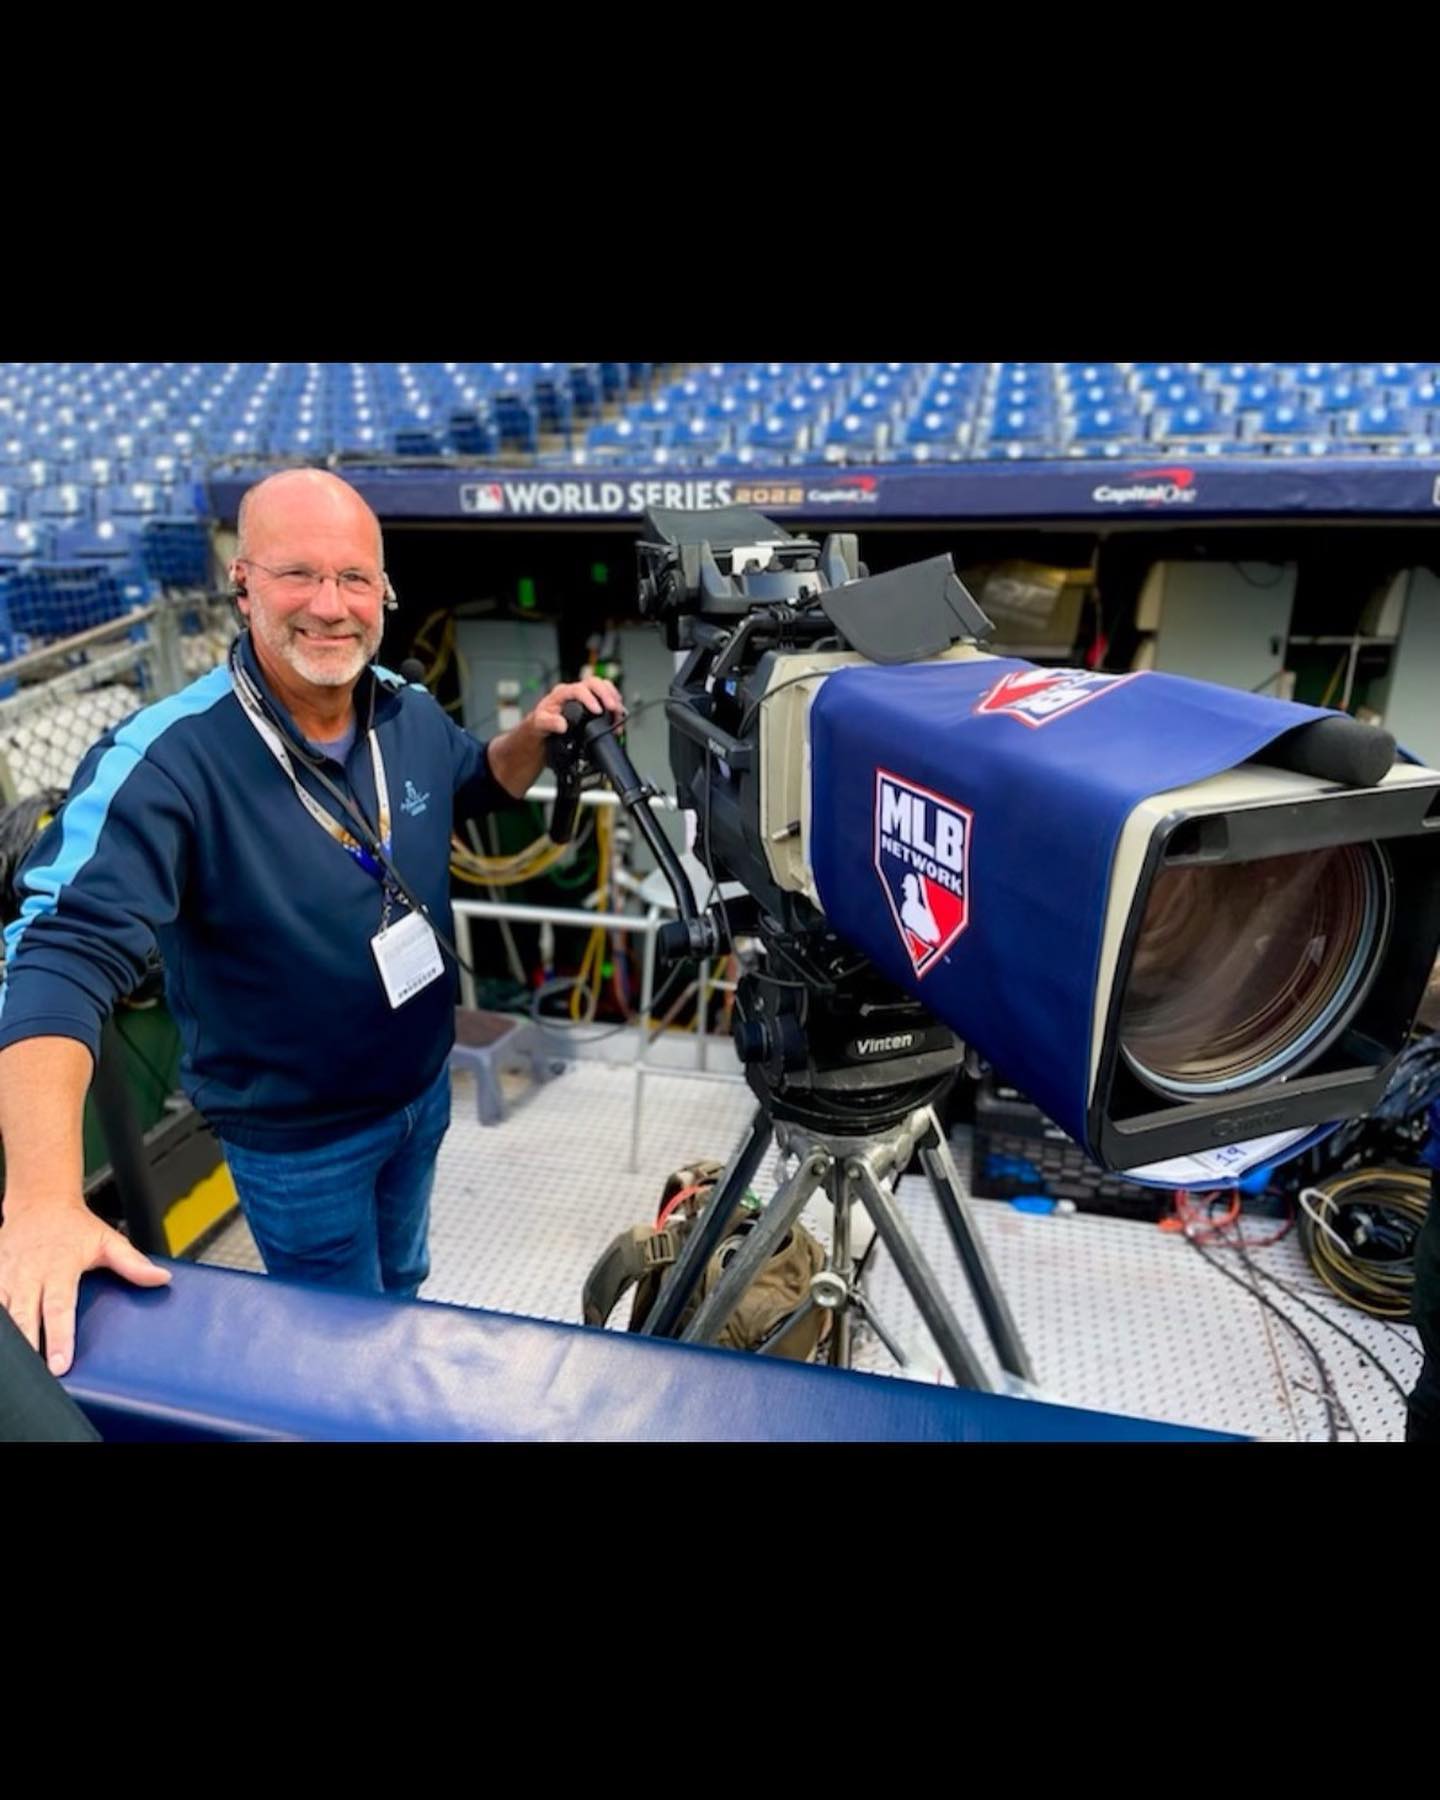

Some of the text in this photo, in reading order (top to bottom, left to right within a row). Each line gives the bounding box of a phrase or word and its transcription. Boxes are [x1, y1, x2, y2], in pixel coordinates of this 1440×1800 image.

[505, 480, 804, 513] WORLD SERIES 2022
[881, 782, 964, 873] MLB
[881, 833, 963, 897] NETWORK
[857, 1033, 913, 1055] Vinten
[1216, 1145, 1248, 1168] 19
